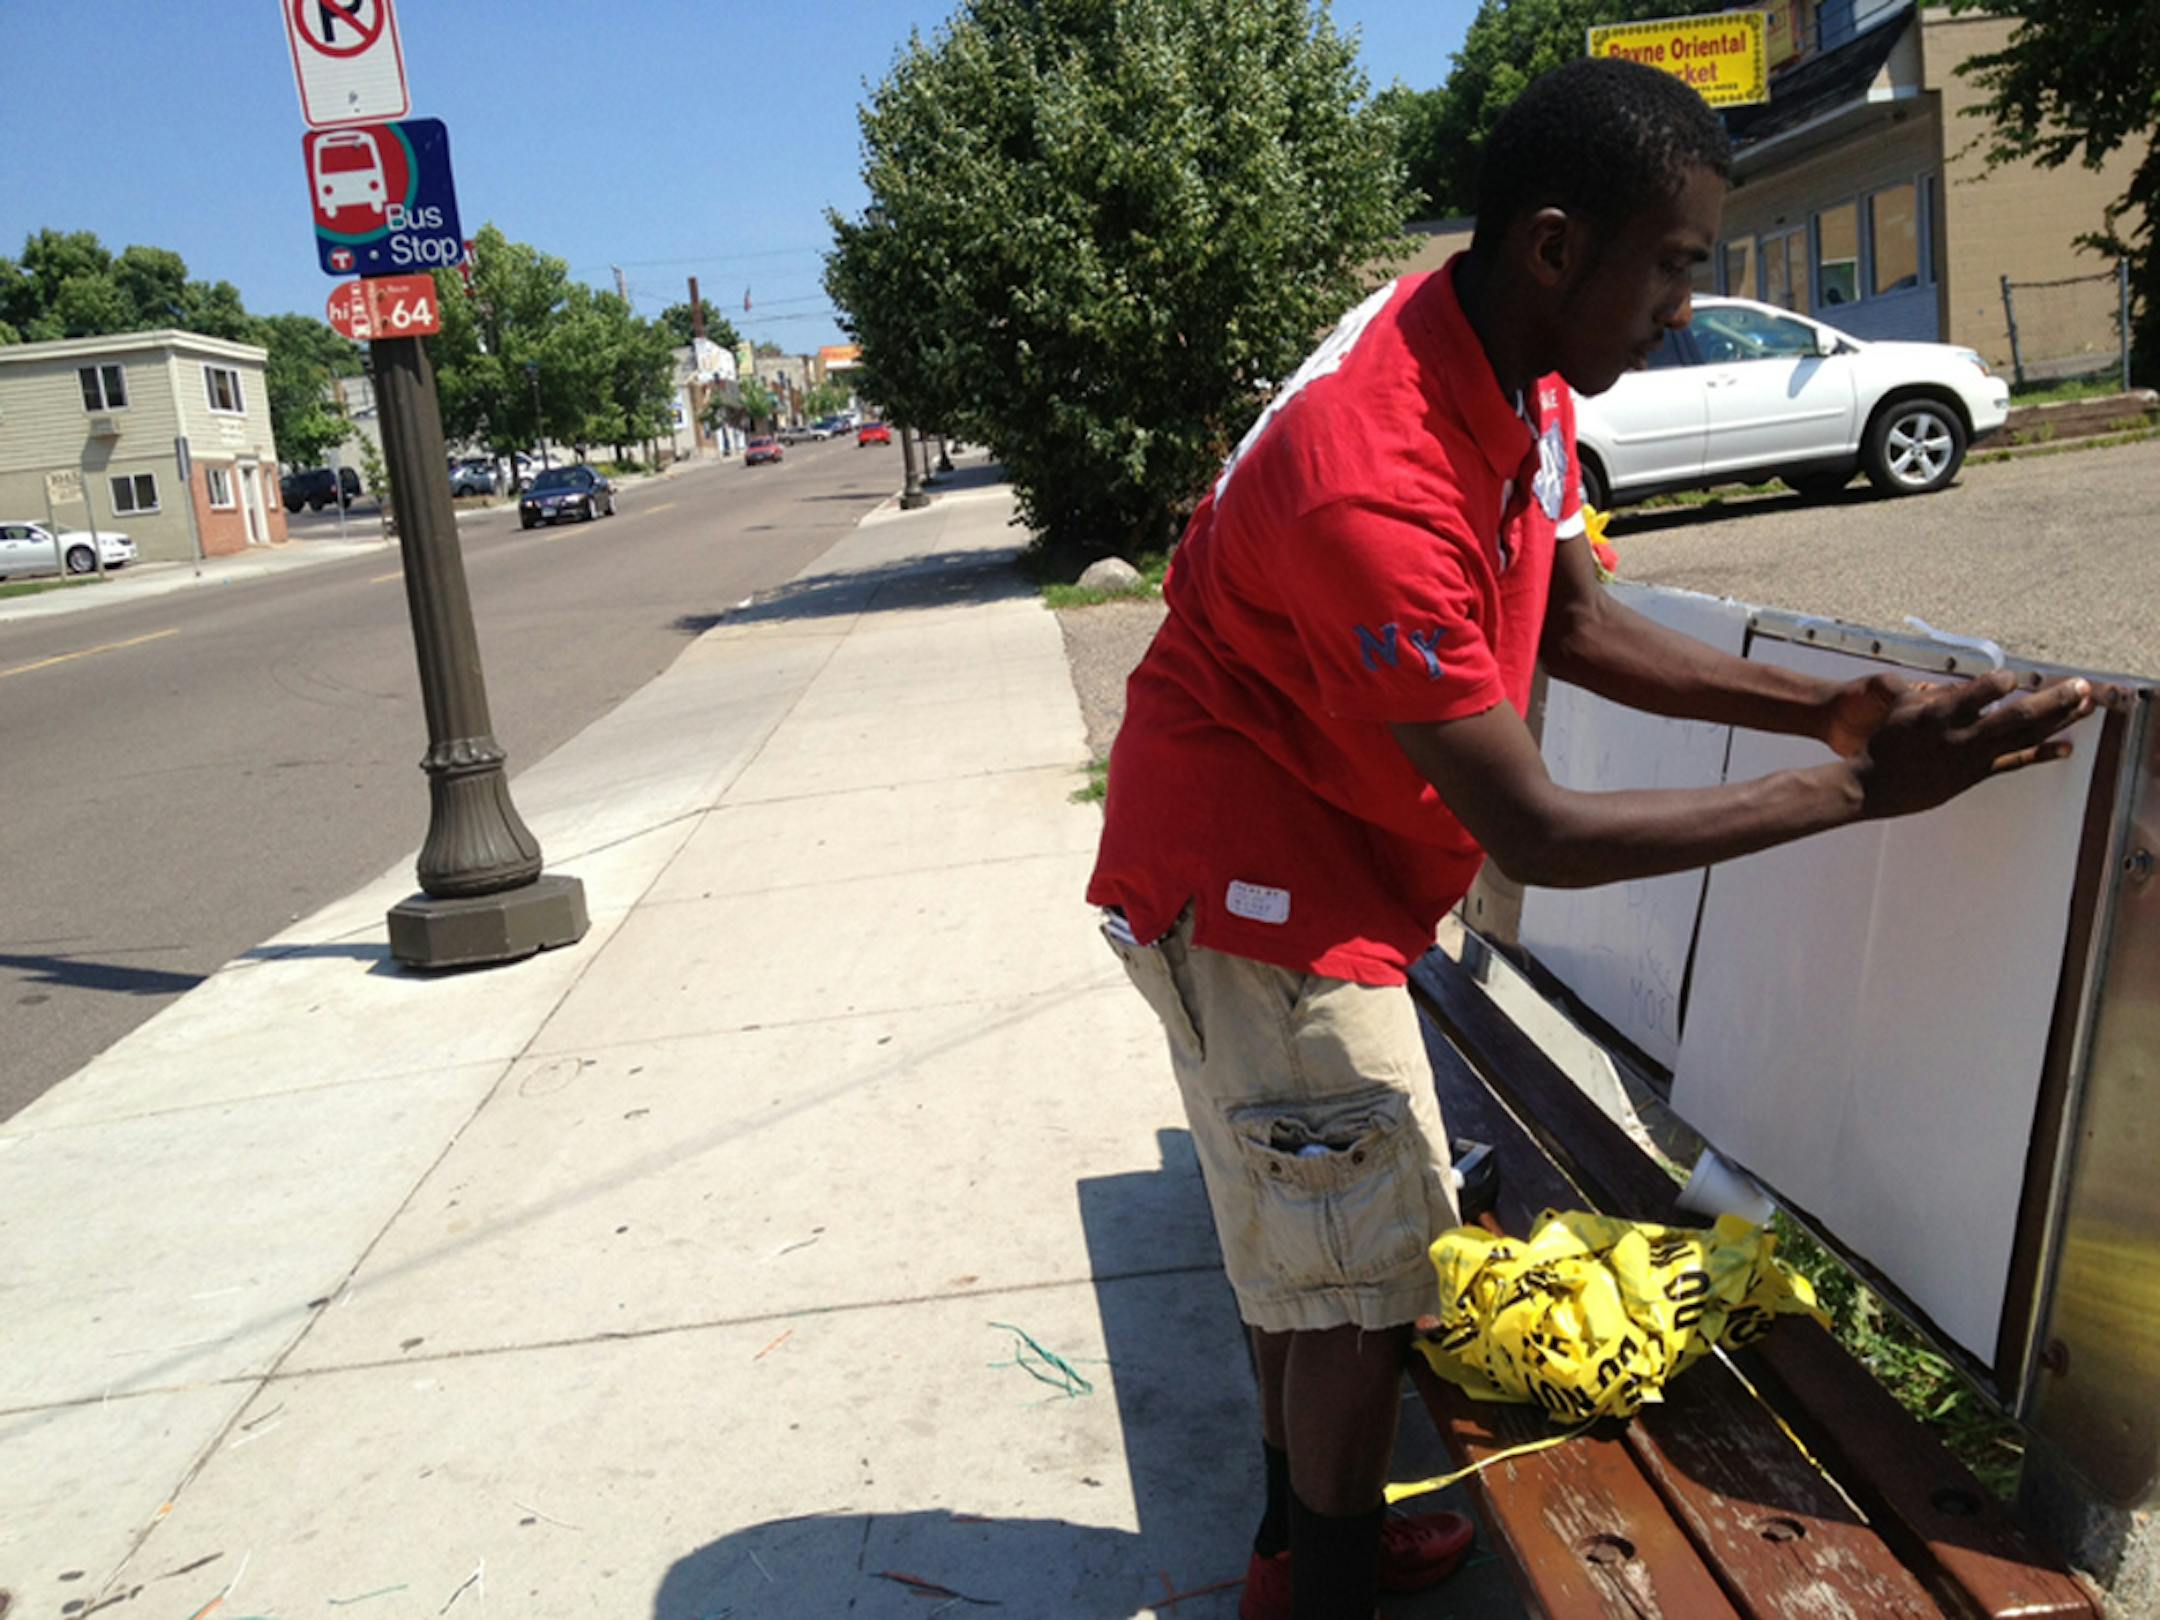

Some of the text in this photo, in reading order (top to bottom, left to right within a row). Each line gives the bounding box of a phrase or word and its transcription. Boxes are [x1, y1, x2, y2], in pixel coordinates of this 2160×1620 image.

[1609, 30, 1746, 64] Payne Oriental
[1673, 61, 1718, 85] rket
[386, 204, 443, 231] Bus
[390, 234, 458, 267] Stop
[329, 302, 350, 321] hi
[391, 297, 433, 329] 64
